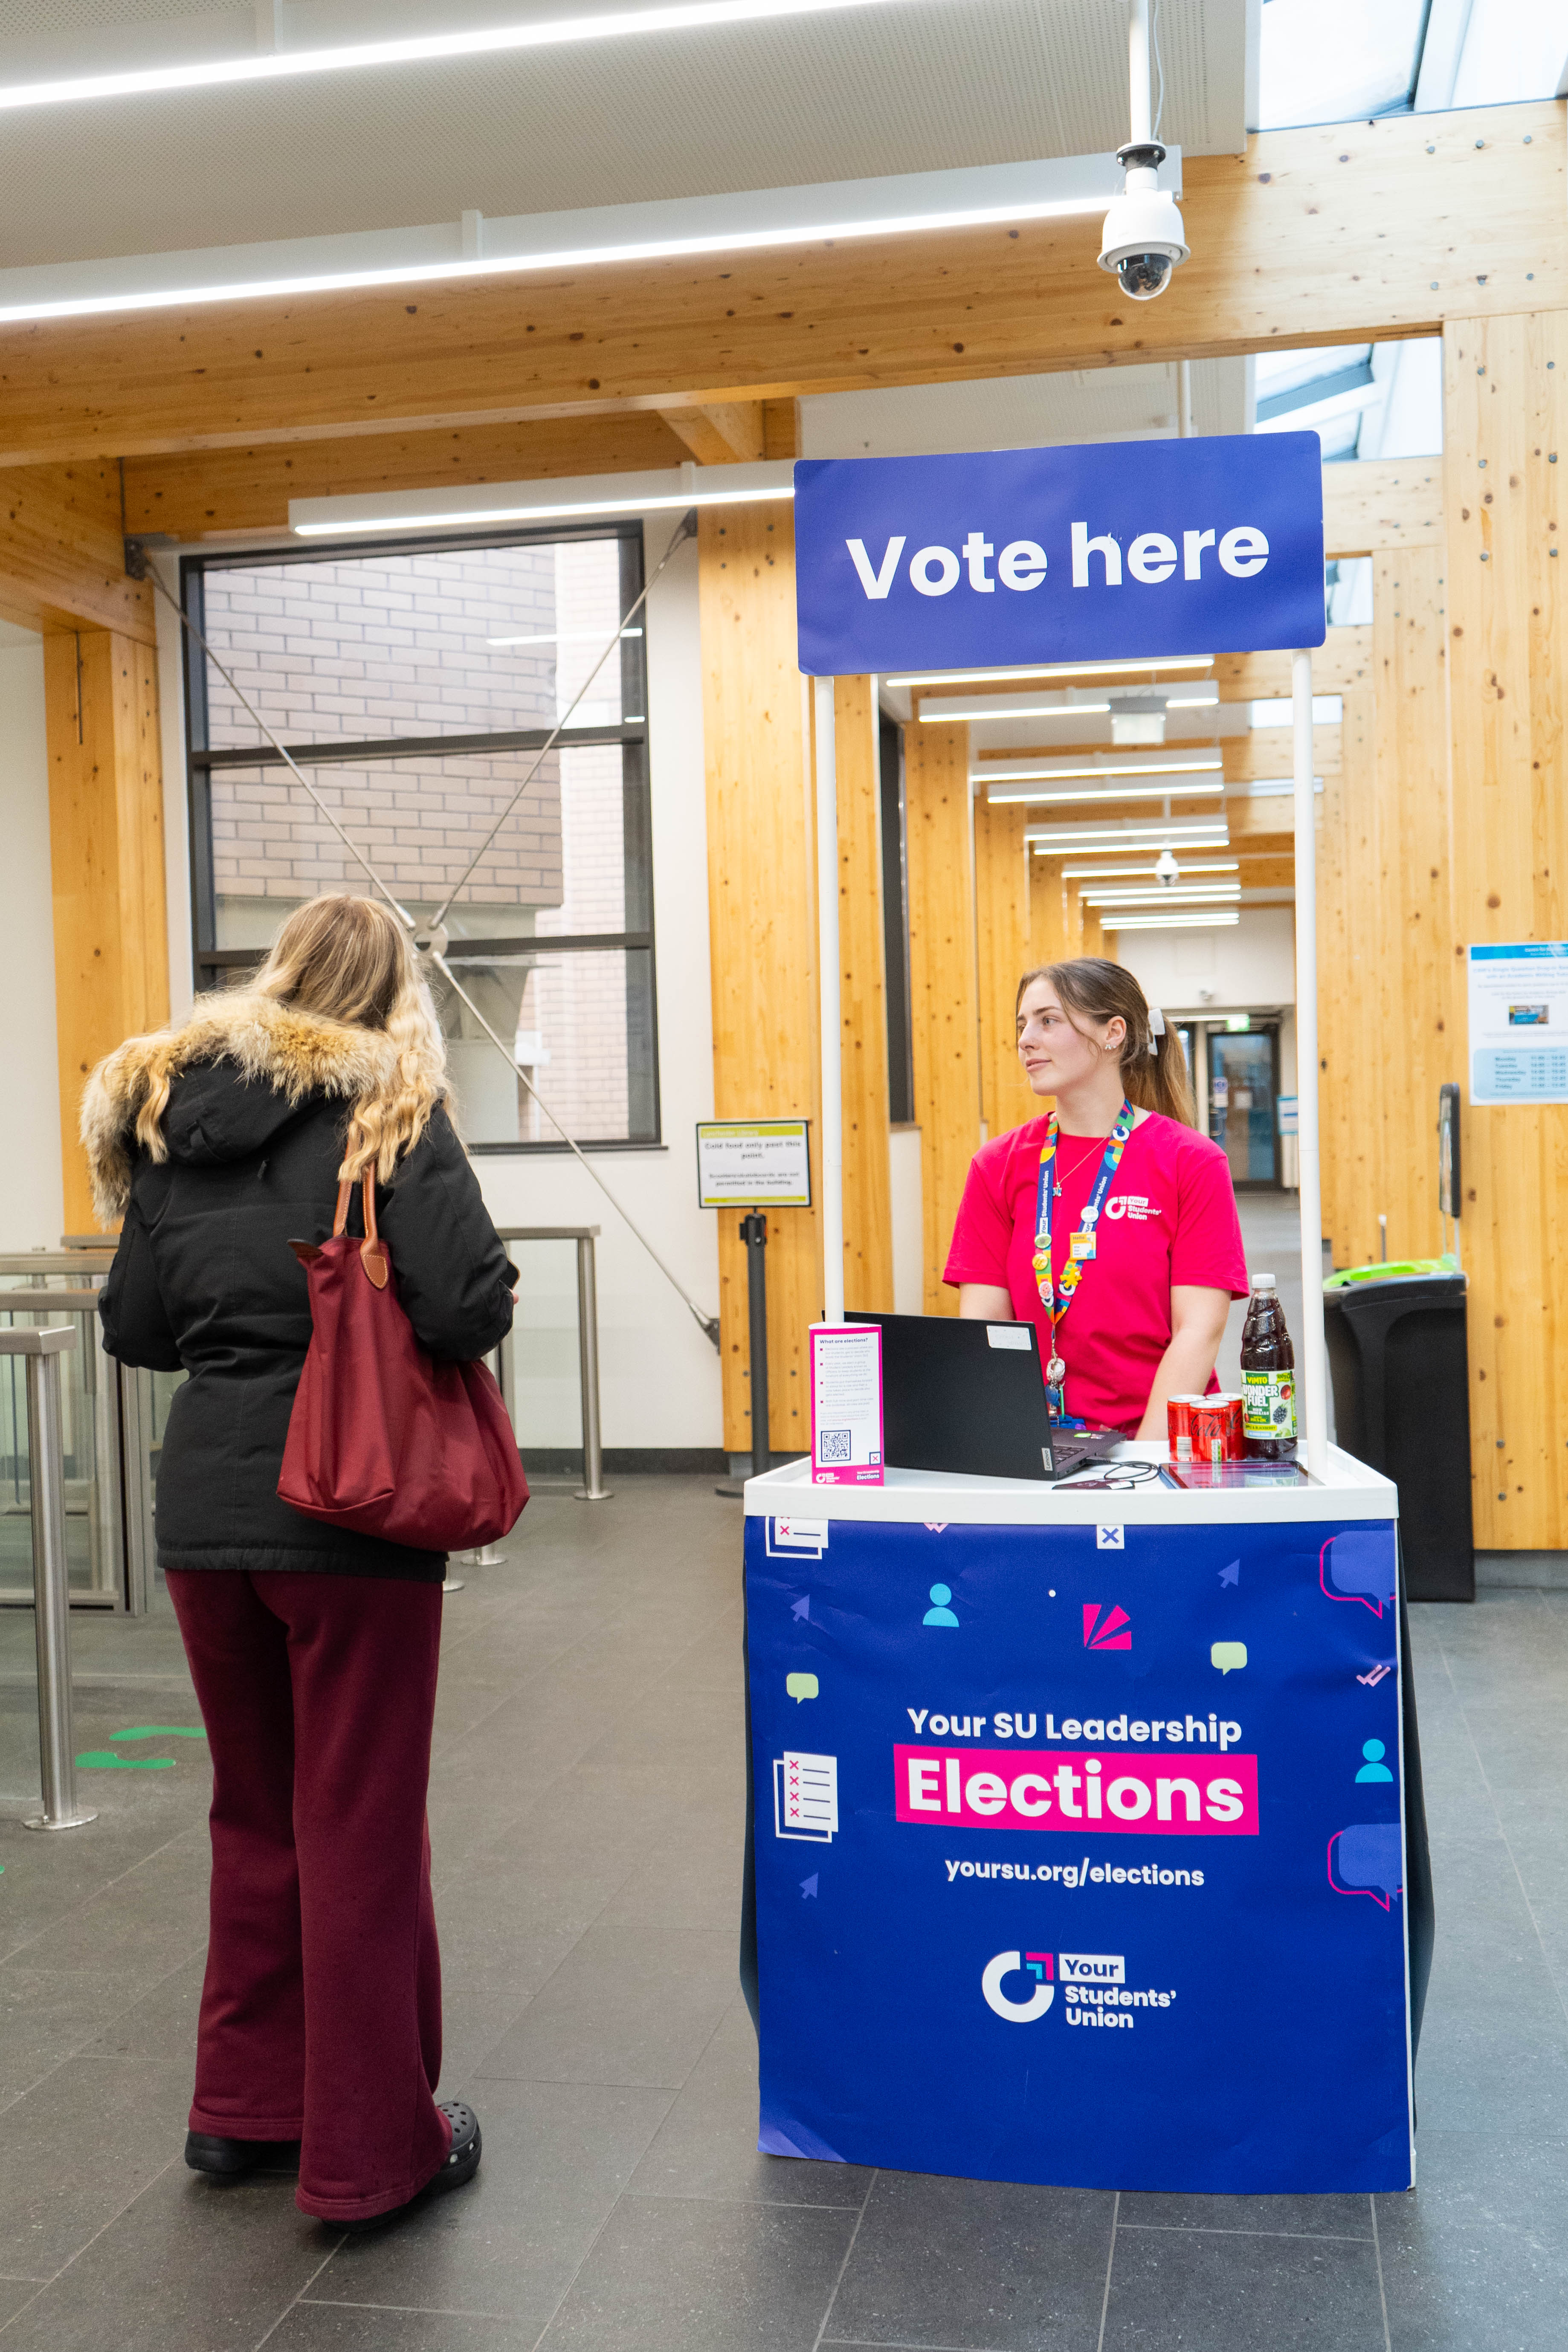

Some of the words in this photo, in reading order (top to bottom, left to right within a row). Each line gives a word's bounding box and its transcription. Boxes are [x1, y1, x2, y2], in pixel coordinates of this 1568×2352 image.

[846, 532, 1047, 599] Vote
[1071, 522, 1269, 587] here
[745, 1141, 762, 1149] only
[1097, 1176, 1108, 1194] Union
[1127, 1205, 1162, 1215] Students'
[1127, 1212, 1148, 1220] Union
[1242, 1384, 1278, 1396] WONDER
[1248, 1395, 1268, 1407] FUEL
[1191, 1413, 1225, 1437] Cola
[907, 1709, 986, 1737] Your
[994, 1713, 1037, 1738] SU
[1046, 1713, 1242, 1751] Leadership
[908, 1758, 1243, 1822] Elections
[945, 1857, 1204, 1888] yoursu.org/elections
[1065, 1959, 1119, 1977] Your
[1066, 2006, 1133, 2028] Union
